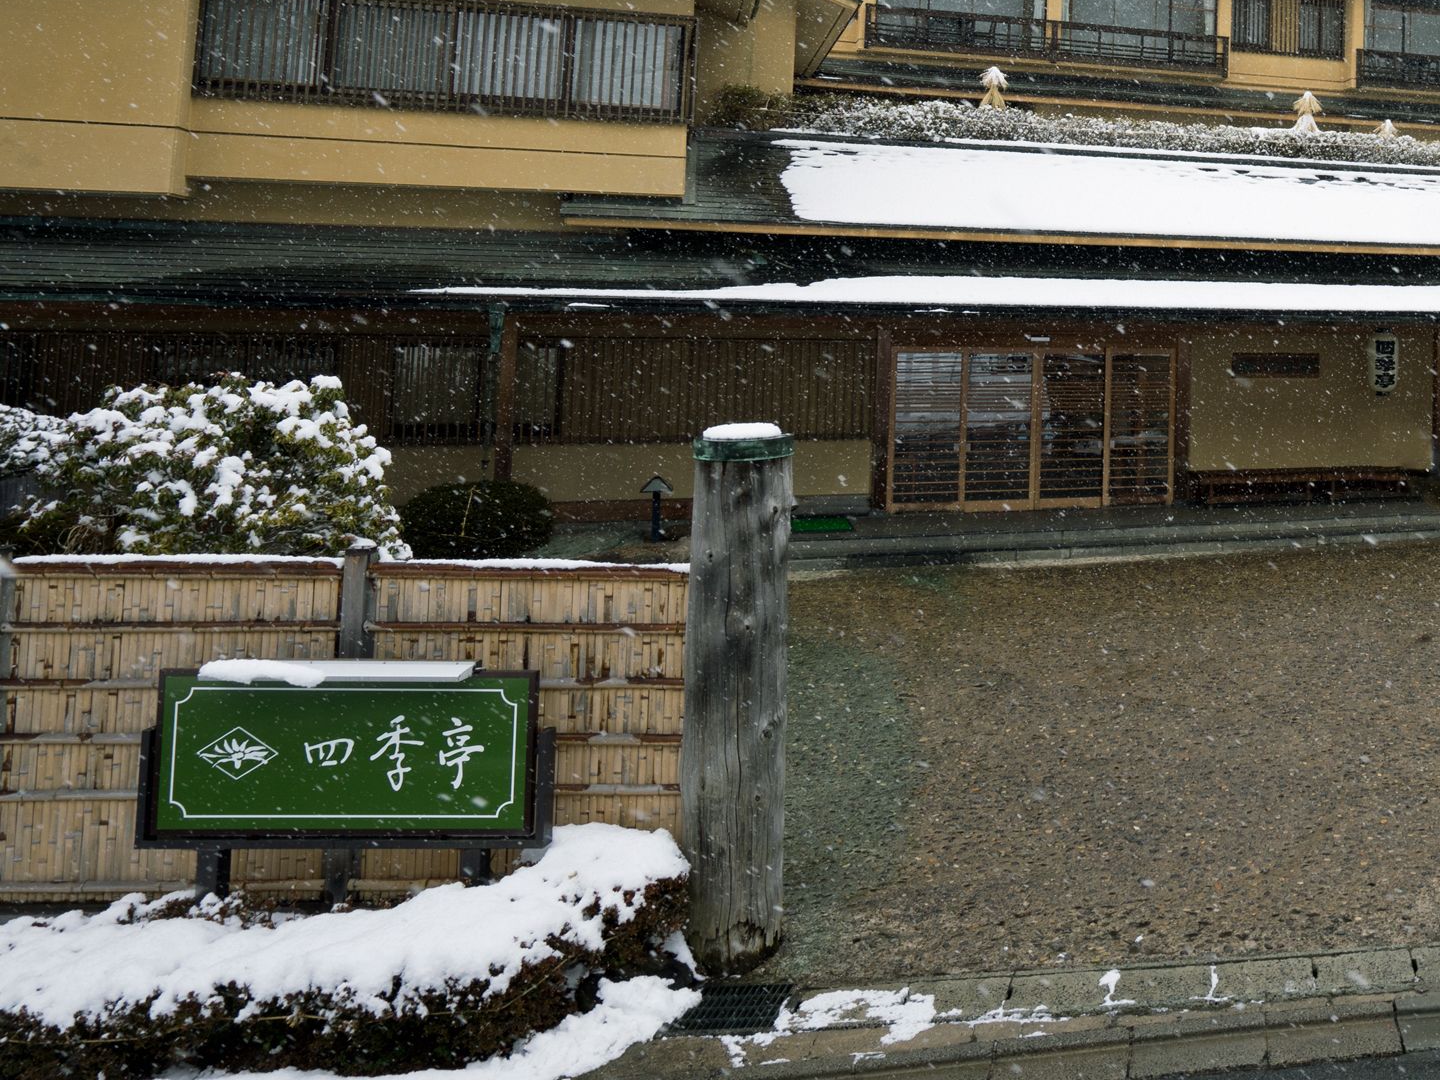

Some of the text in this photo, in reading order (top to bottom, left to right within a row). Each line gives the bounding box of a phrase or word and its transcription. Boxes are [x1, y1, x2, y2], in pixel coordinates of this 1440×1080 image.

[1375, 340, 1396, 388] 四季亭
[304, 715, 485, 792] 四季亭
